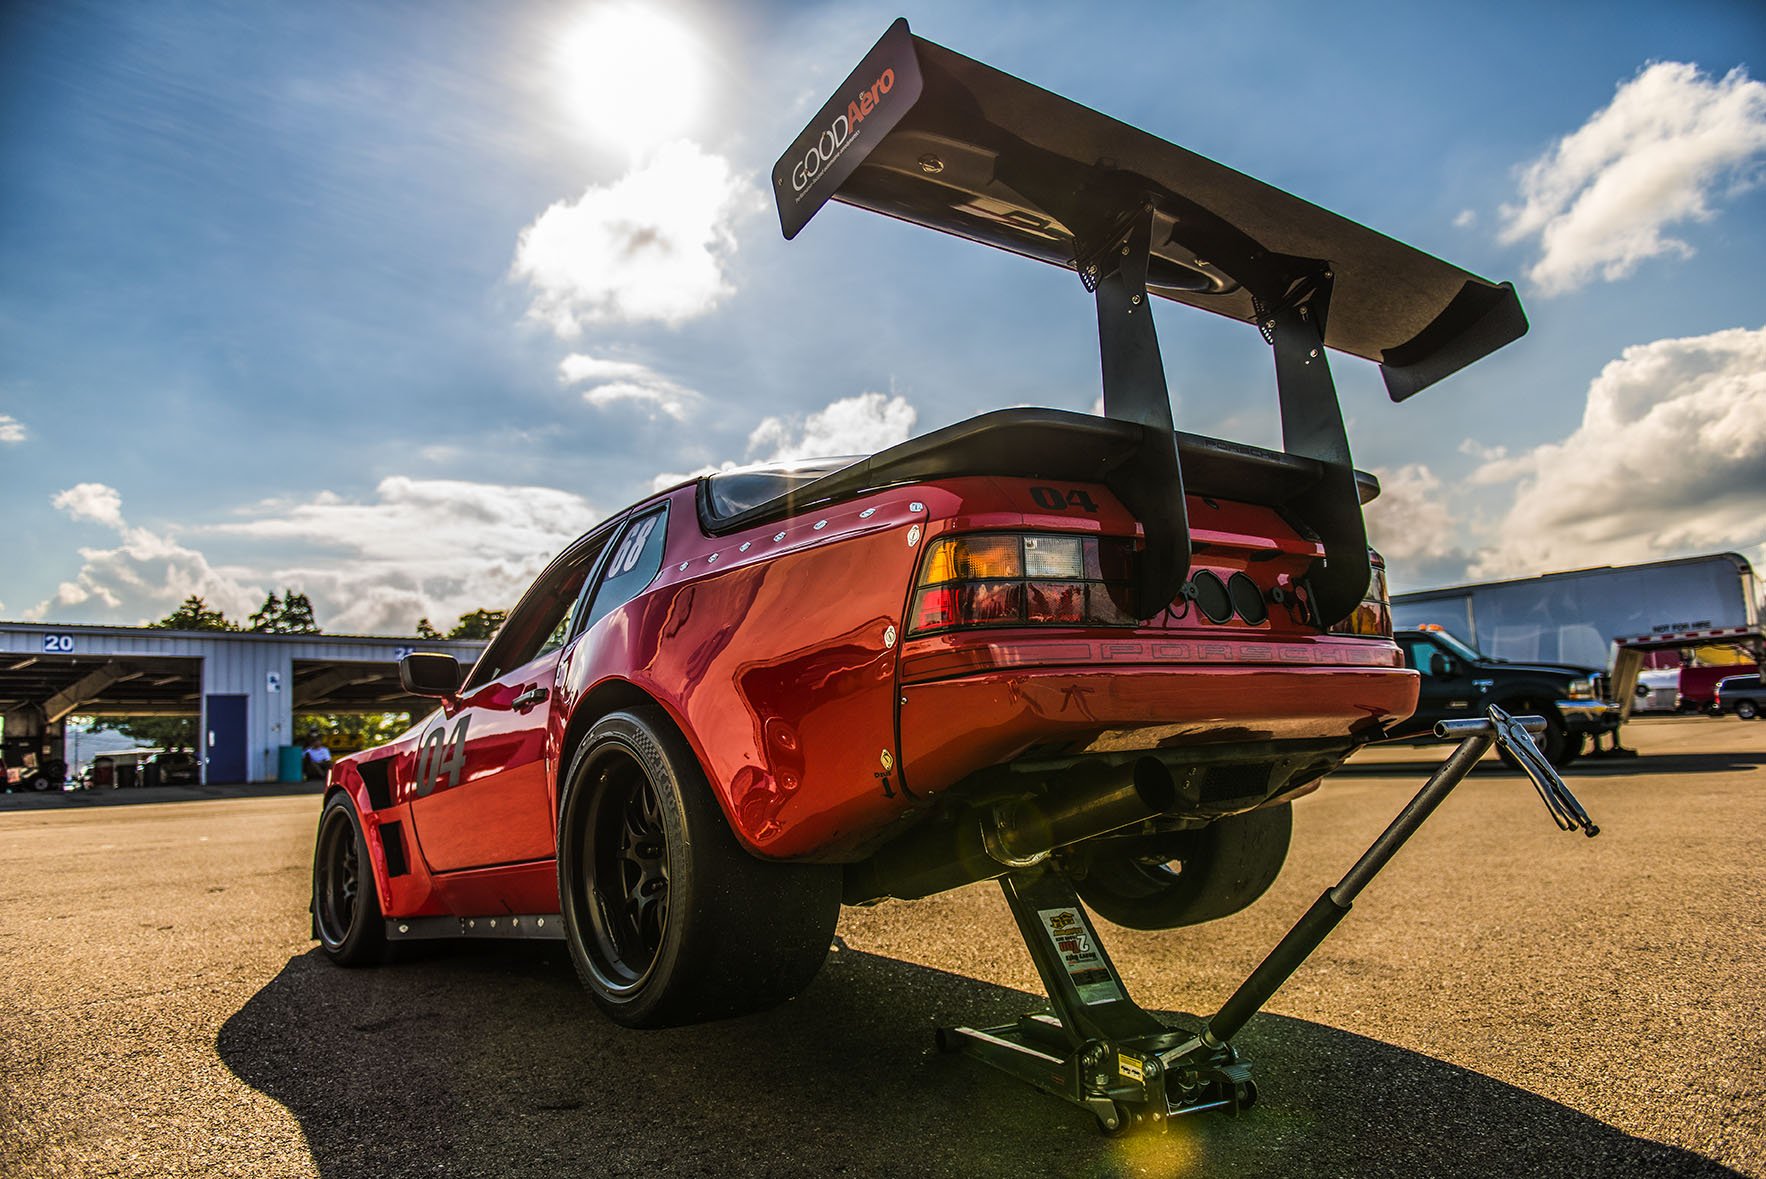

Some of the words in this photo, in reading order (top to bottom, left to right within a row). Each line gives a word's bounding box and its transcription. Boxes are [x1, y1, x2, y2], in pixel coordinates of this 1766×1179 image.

[1030, 487, 1098, 512] 04
[608, 516, 657, 578] 68
[45, 635, 73, 651] 20
[1101, 643, 1372, 663] PORSCHE
[416, 713, 472, 796] 04
